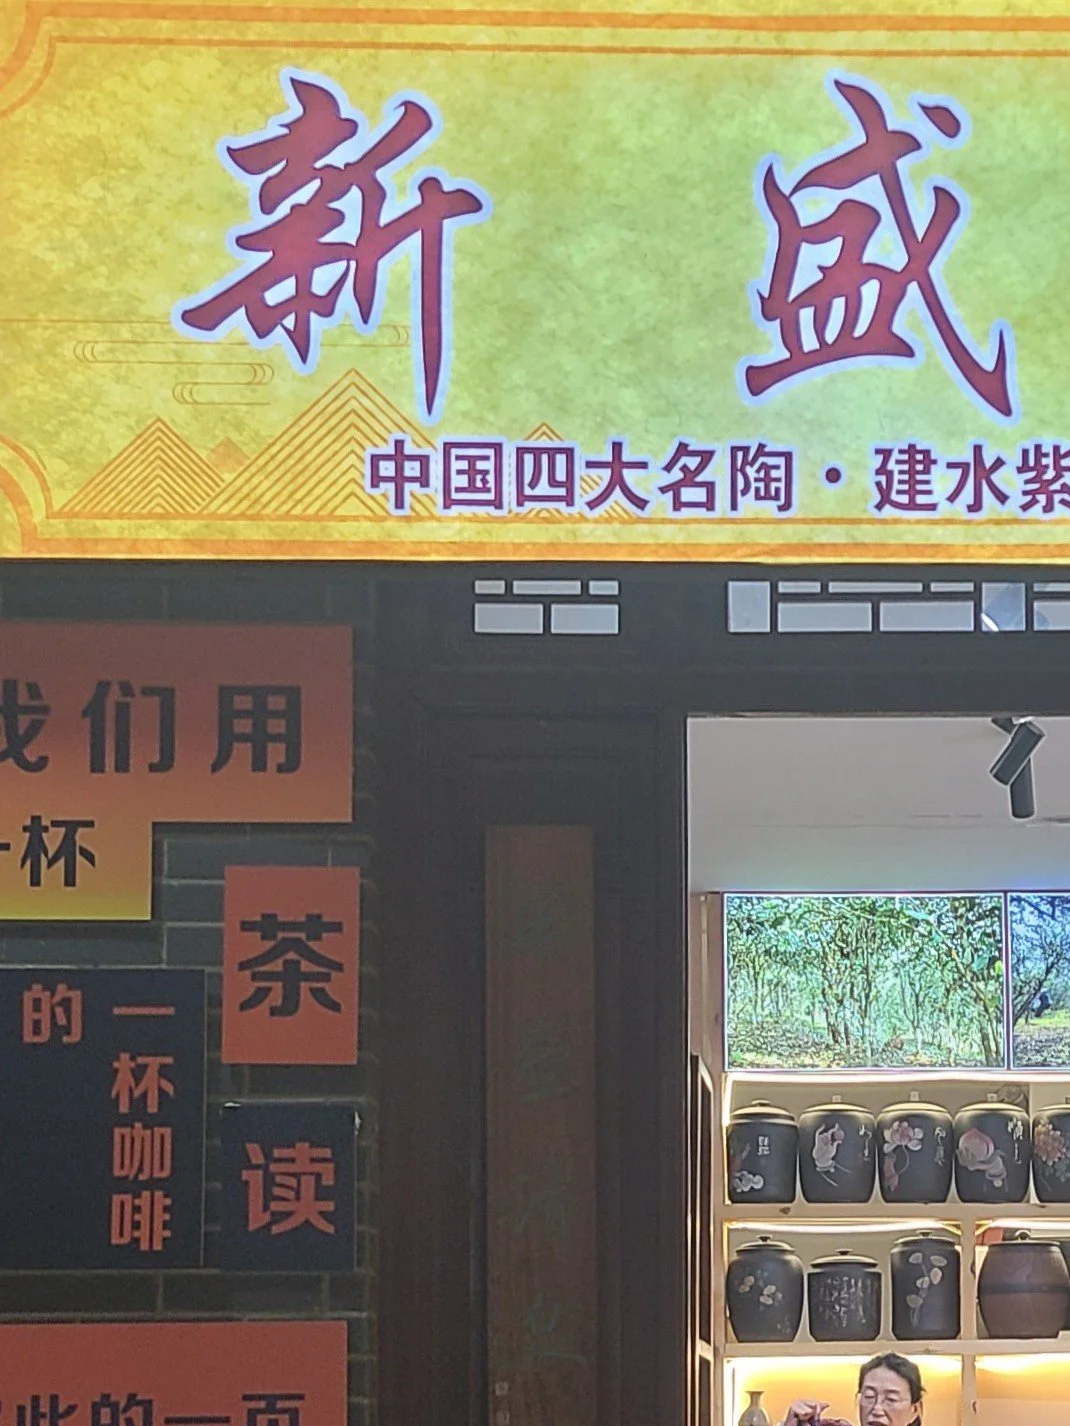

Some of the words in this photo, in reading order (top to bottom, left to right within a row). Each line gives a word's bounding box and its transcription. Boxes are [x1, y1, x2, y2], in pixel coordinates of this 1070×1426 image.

[0, 814, 97, 889] 杯
[237, 911, 345, 1018] 茶
[241, 1141, 337, 1236] 读
